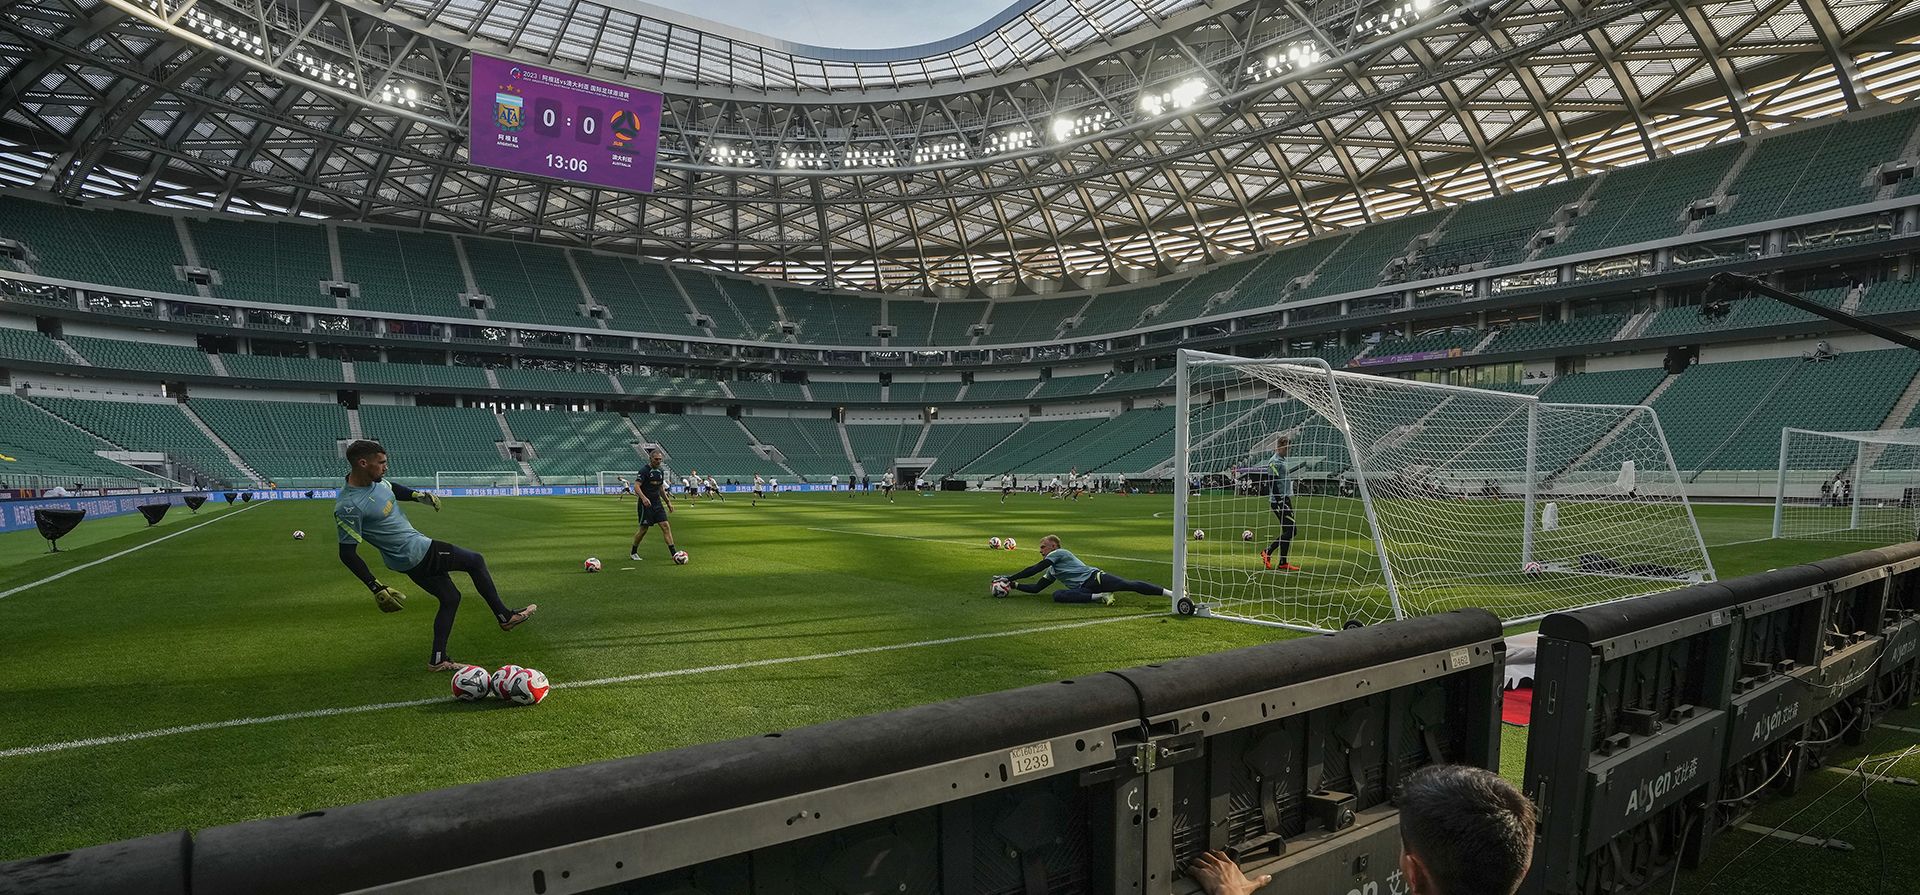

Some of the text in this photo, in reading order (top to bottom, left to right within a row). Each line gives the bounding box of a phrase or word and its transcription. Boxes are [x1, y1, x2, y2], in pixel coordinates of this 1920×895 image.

[523, 71, 538, 80] 2023
[543, 109, 556, 127] 0
[583, 116, 596, 135] 0
[545, 153, 589, 173] 13:06
[1751, 710, 1782, 742] Absen
[1016, 753, 1049, 773] 1239
[1624, 757, 1699, 817] Absen 艾比森
